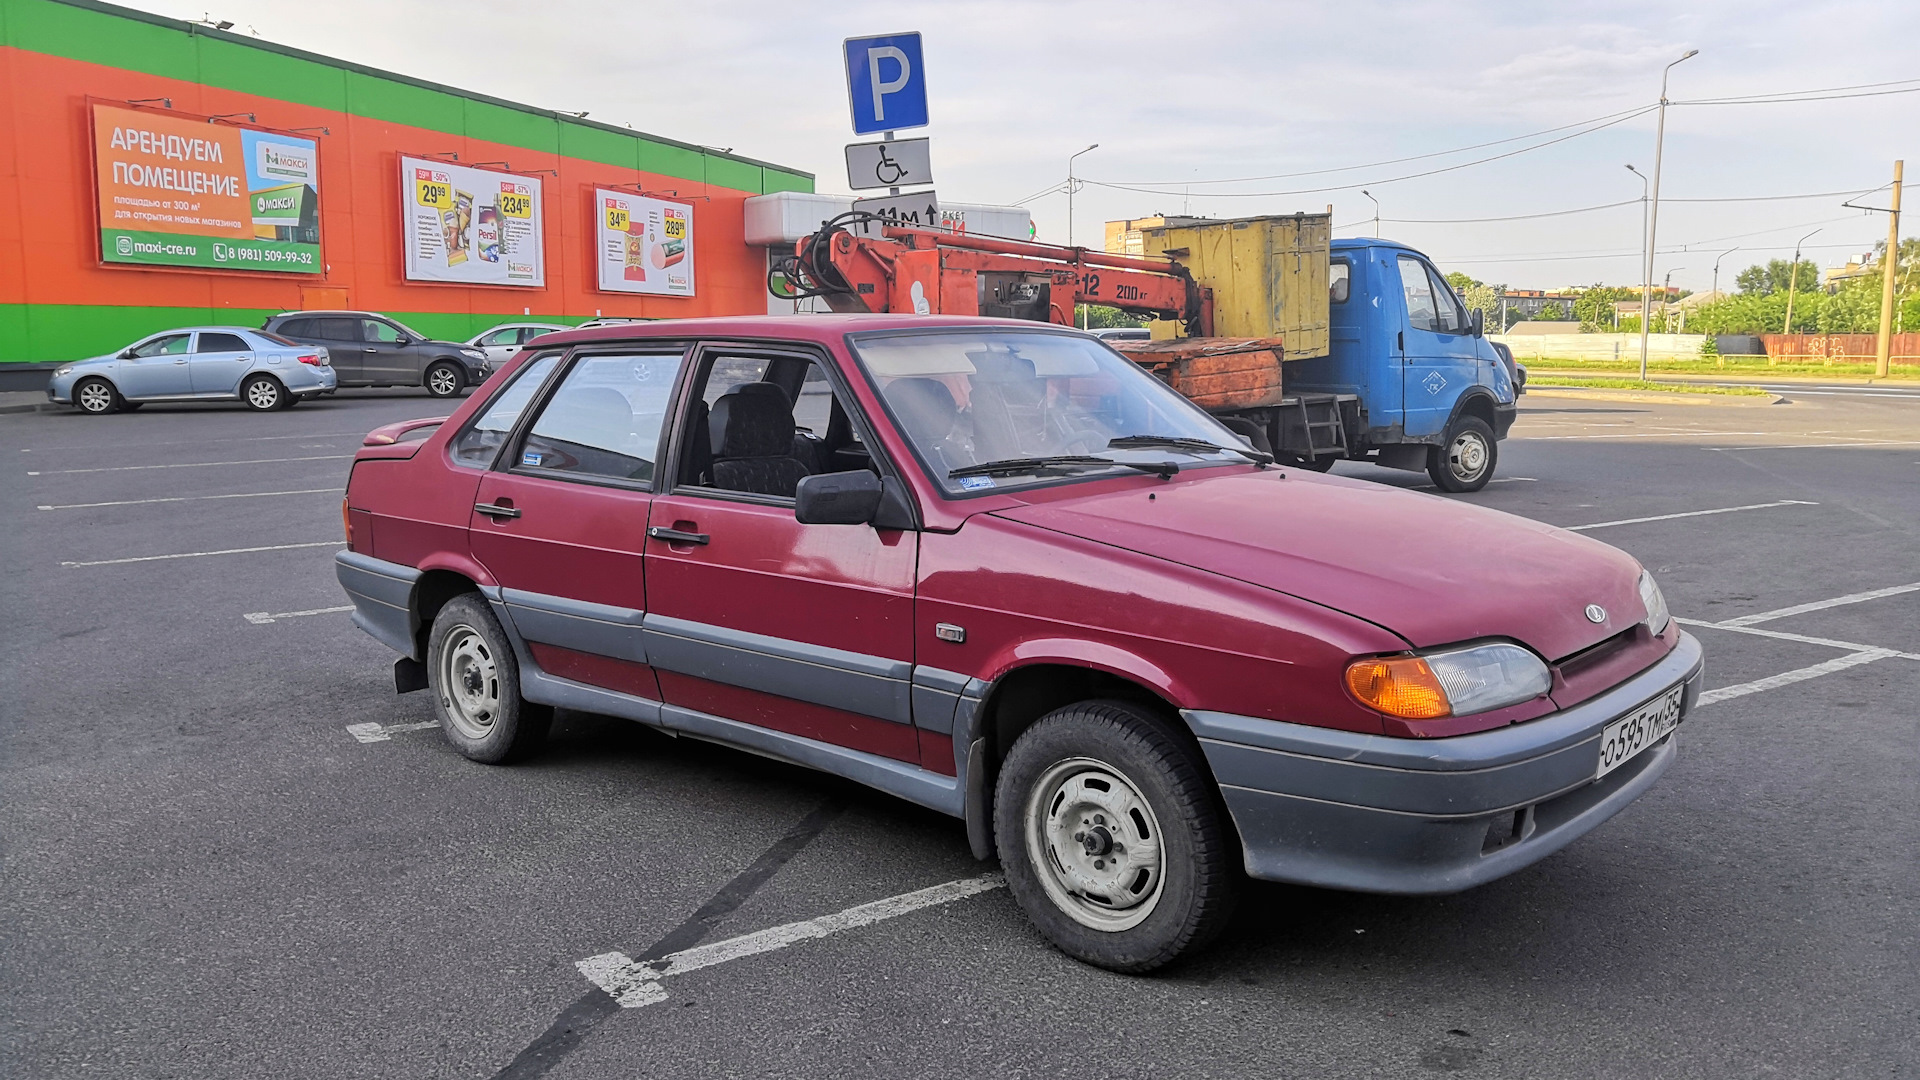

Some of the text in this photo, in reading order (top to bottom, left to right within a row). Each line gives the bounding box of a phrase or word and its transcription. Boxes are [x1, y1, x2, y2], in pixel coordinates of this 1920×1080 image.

[867, 46, 911, 122] P
[111, 126, 223, 164] АРЕНДУЕМ
[113, 161, 240, 198] ПОМЕЩЕНИЕ
[114, 196, 160, 208] площадью
[162, 200, 171, 209] от
[173, 200, 190, 211] 300
[114, 209, 242, 229] для открытия новых магазинов
[941, 210, 966, 220] РКЕТ
[478, 228, 498, 241] Persil
[134, 241, 197, 257] maxi-cre.ru
[228, 247, 313, 264] 8 (981) 509-99-32
[1115, 283, 1138, 301] 200
